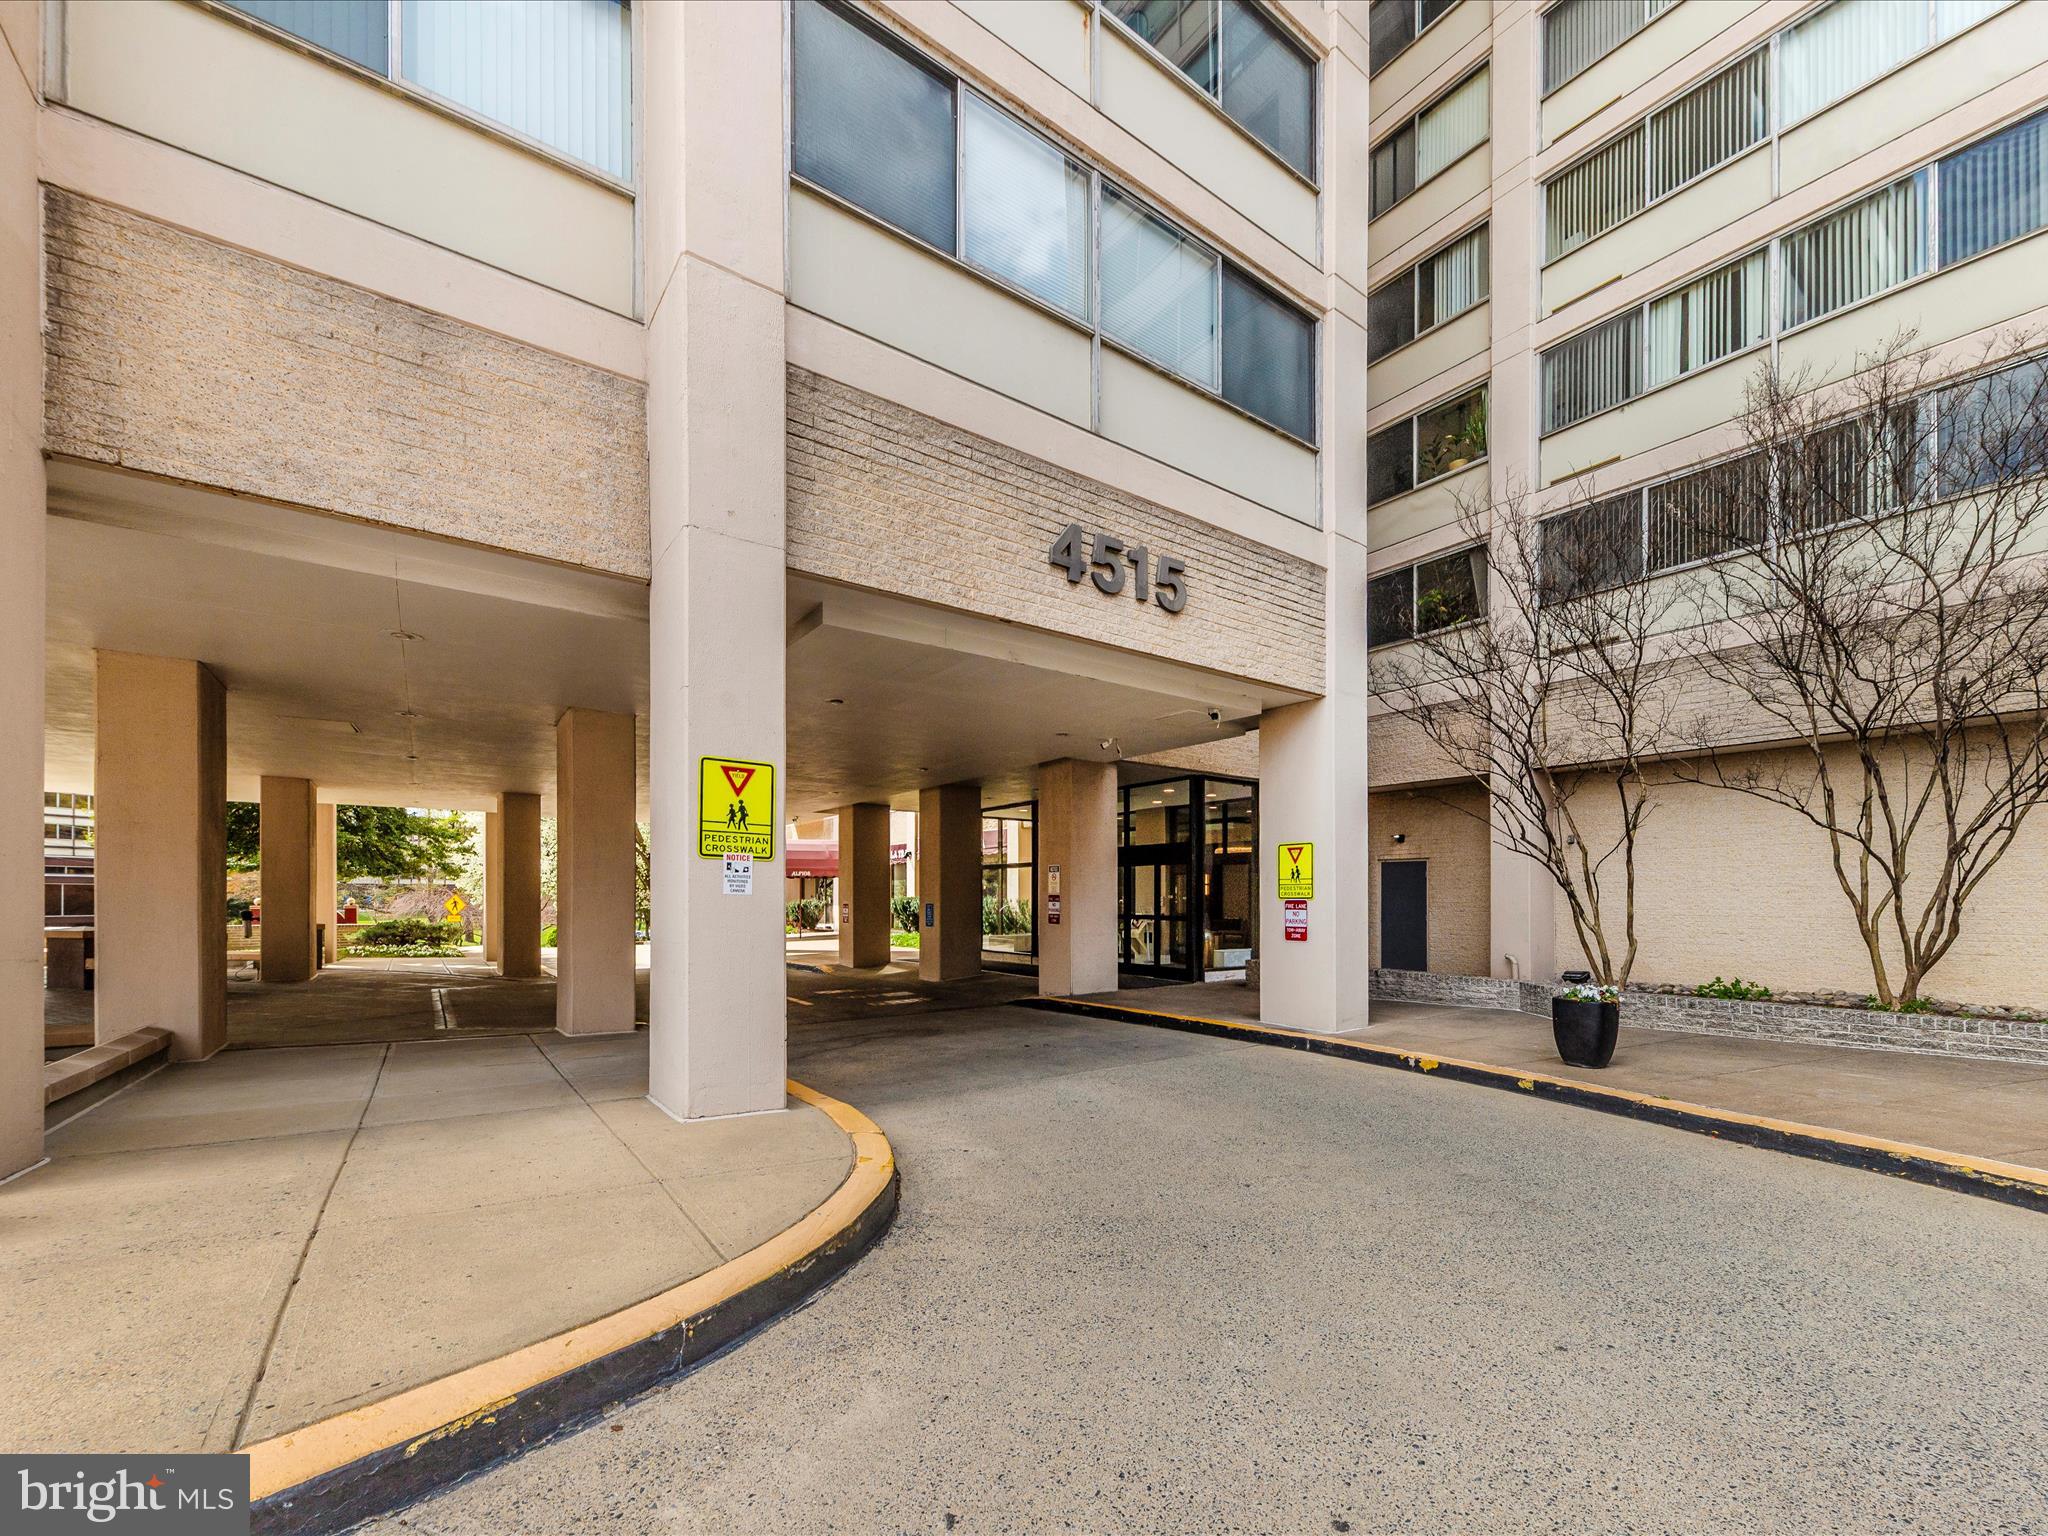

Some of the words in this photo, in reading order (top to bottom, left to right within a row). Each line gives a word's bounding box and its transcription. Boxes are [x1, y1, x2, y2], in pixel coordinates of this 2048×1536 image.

[1049, 522, 1187, 613] 4515
[704, 834, 769, 845] PEDESTRIAN
[705, 844, 768, 855] CROSSWALK
